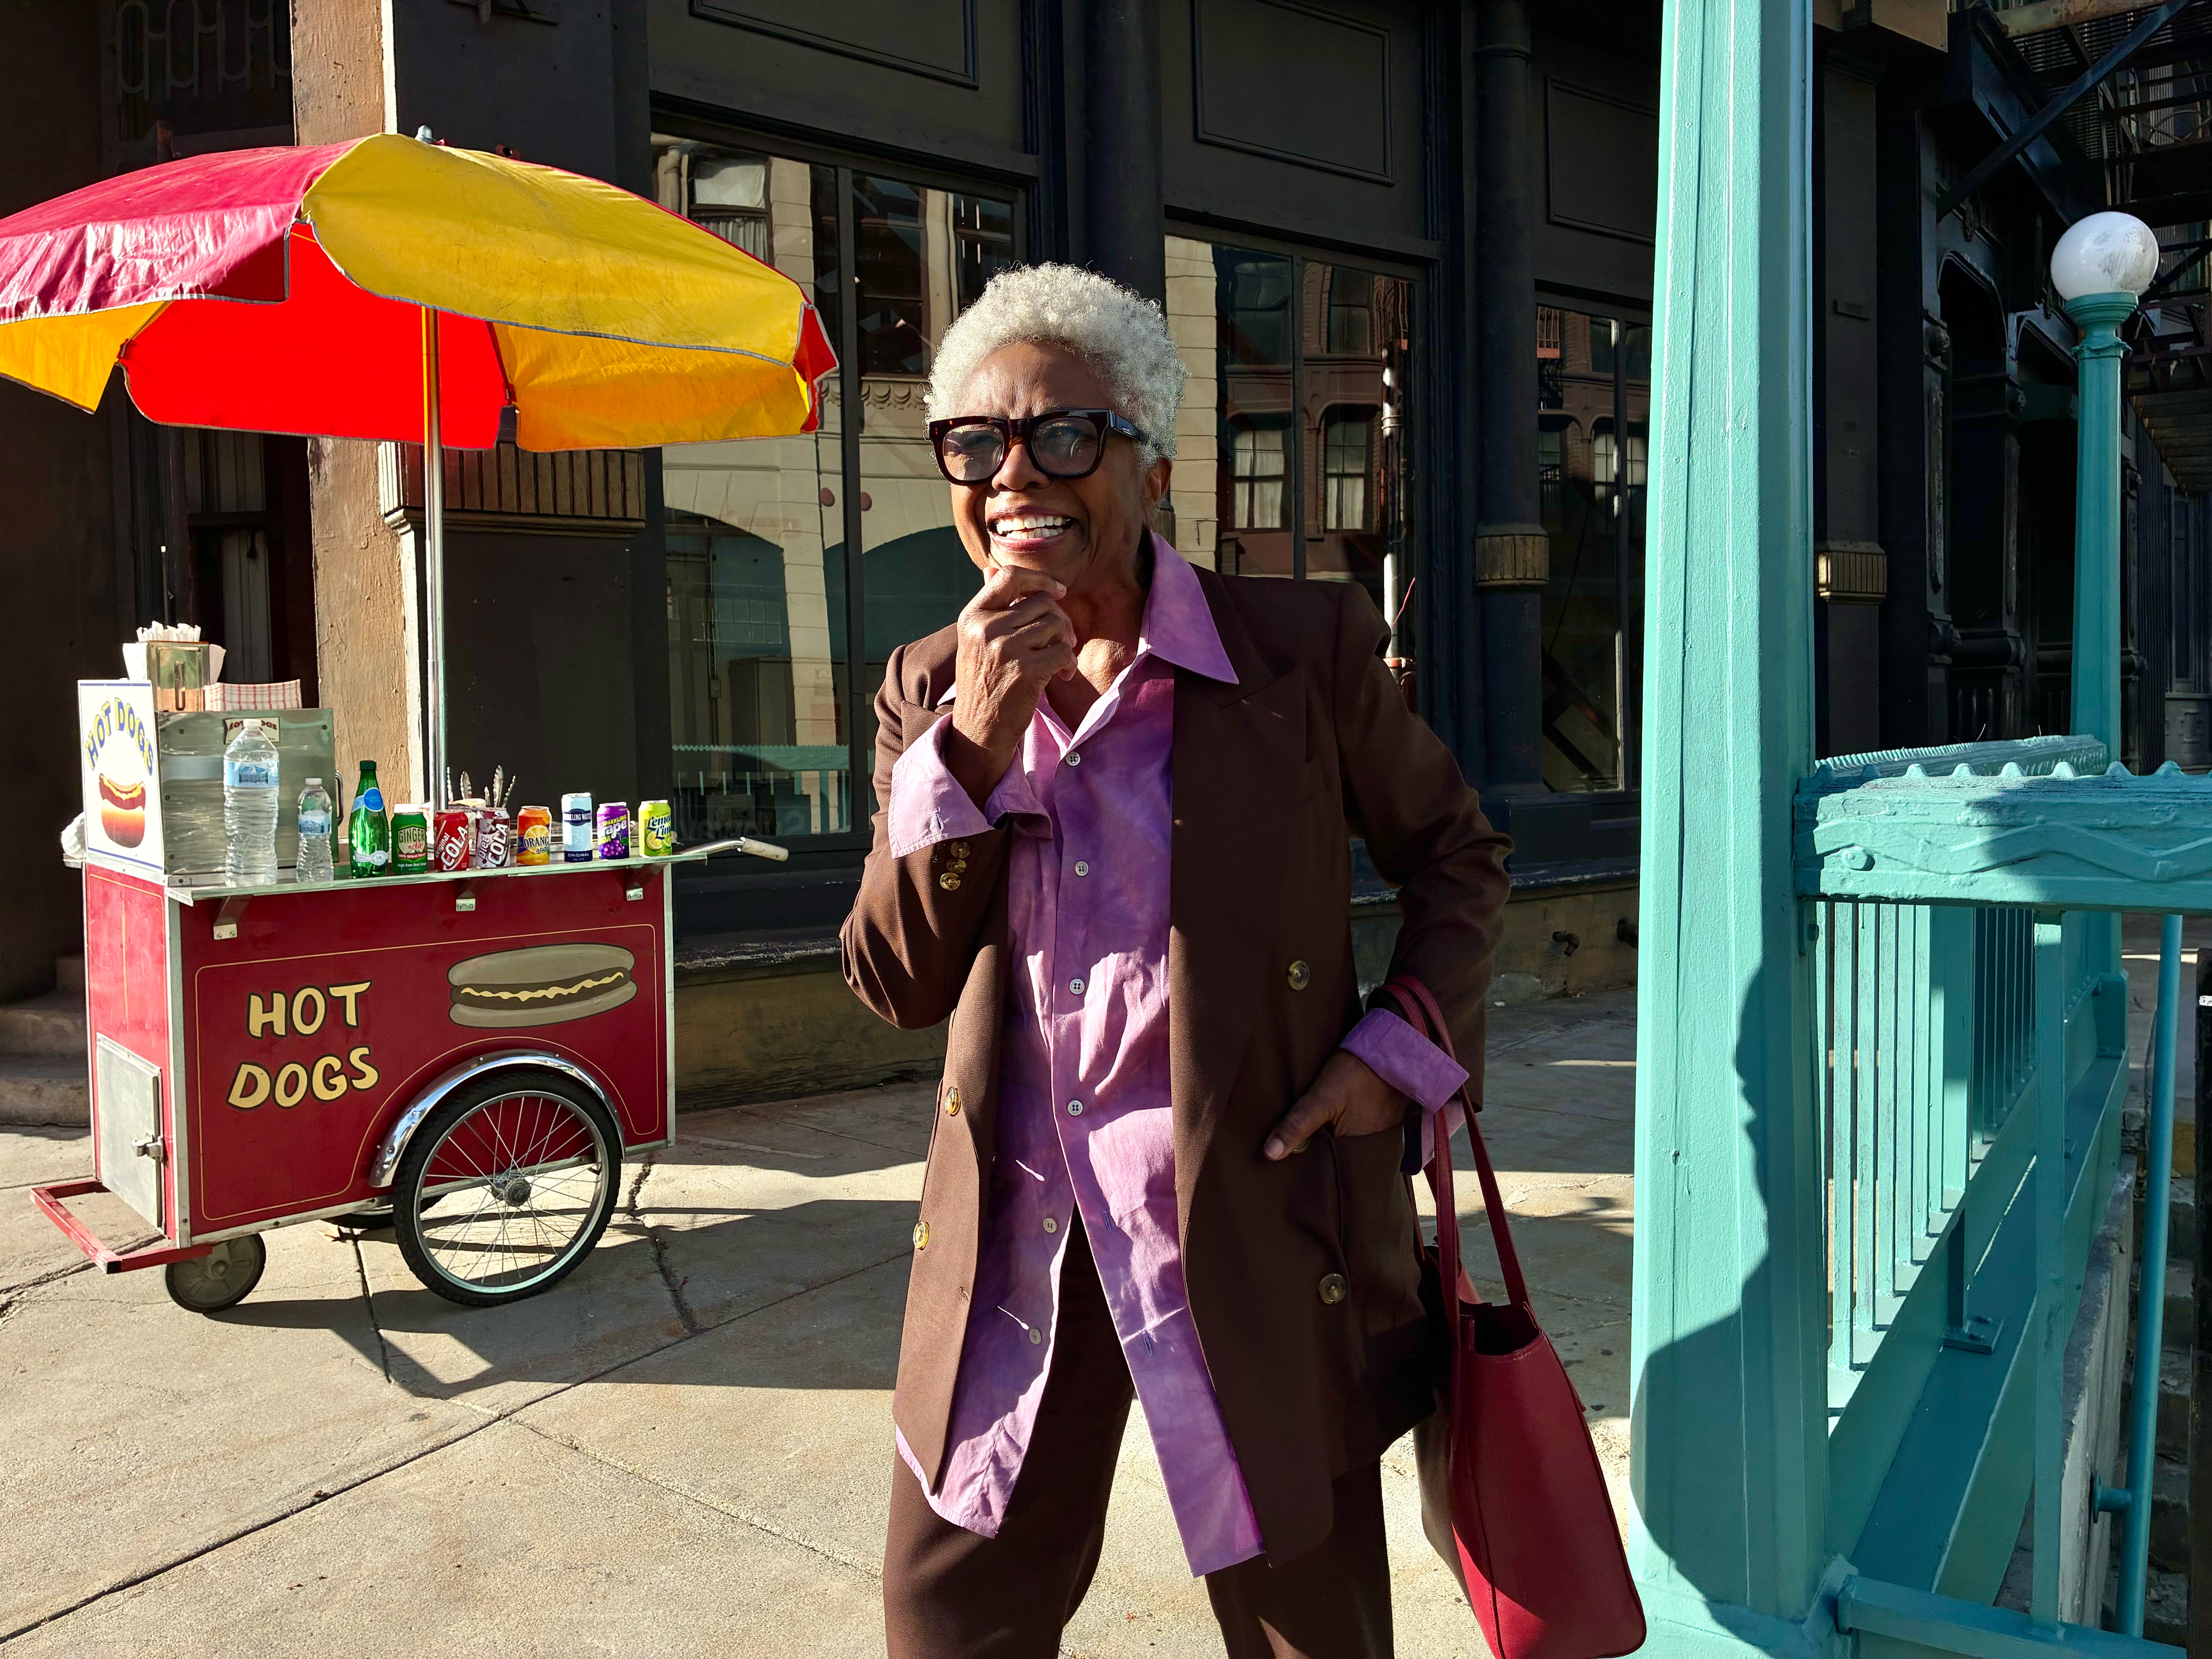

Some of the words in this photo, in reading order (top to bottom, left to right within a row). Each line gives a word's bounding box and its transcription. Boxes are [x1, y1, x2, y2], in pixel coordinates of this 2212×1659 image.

[85, 700, 111, 771] HOT
[114, 697, 154, 777] DOGS
[582, 812, 591, 820] WATE
[647, 815, 671, 831] Lemo
[399, 828, 425, 843] GINGER
[598, 820, 627, 839] rape
[656, 825, 671, 839] Lim
[408, 841, 423, 850] Ale
[435, 832, 450, 858] Original
[441, 826, 468, 866] COLA
[478, 836, 490, 860] Diet
[488, 823, 508, 865] COLA
[524, 836, 549, 849] ORANG
[598, 835, 611, 846] ODA
[247, 979, 373, 1039] HOT
[225, 1046, 379, 1111] DOGS
